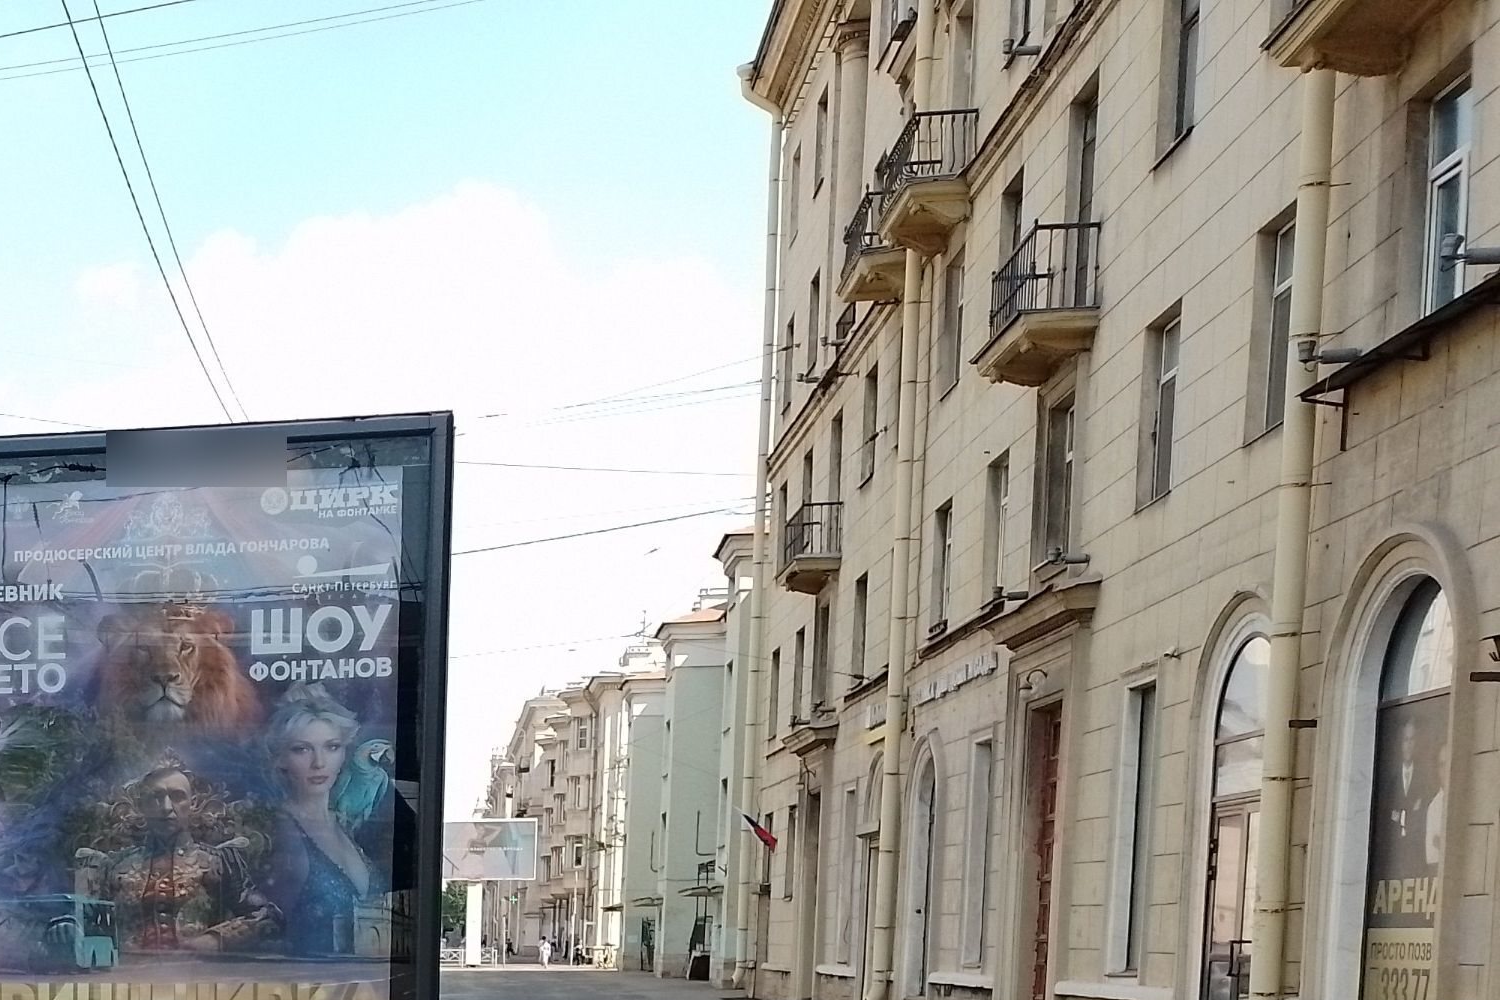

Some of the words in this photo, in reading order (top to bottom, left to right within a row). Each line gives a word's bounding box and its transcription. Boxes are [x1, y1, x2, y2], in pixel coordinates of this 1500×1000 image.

[290, 485, 398, 512] ЦИРК
[318, 509, 334, 519] НА
[337, 505, 397, 517] ФОНТАНКЕ
[14, 545, 132, 564] ПРОДЮСЕРСКИЙ
[135, 544, 182, 560] ЦЕНТР
[185, 542, 236, 557] ВЛАДА
[239, 537, 330, 553] ГОНЧАРОВА
[251, 603, 392, 656] ШОУ
[249, 656, 393, 682] ФОНТАНОВ
[1371, 943, 1406, 961] ПРОСТО
[1409, 942, 1432, 961] ПОЗВ
